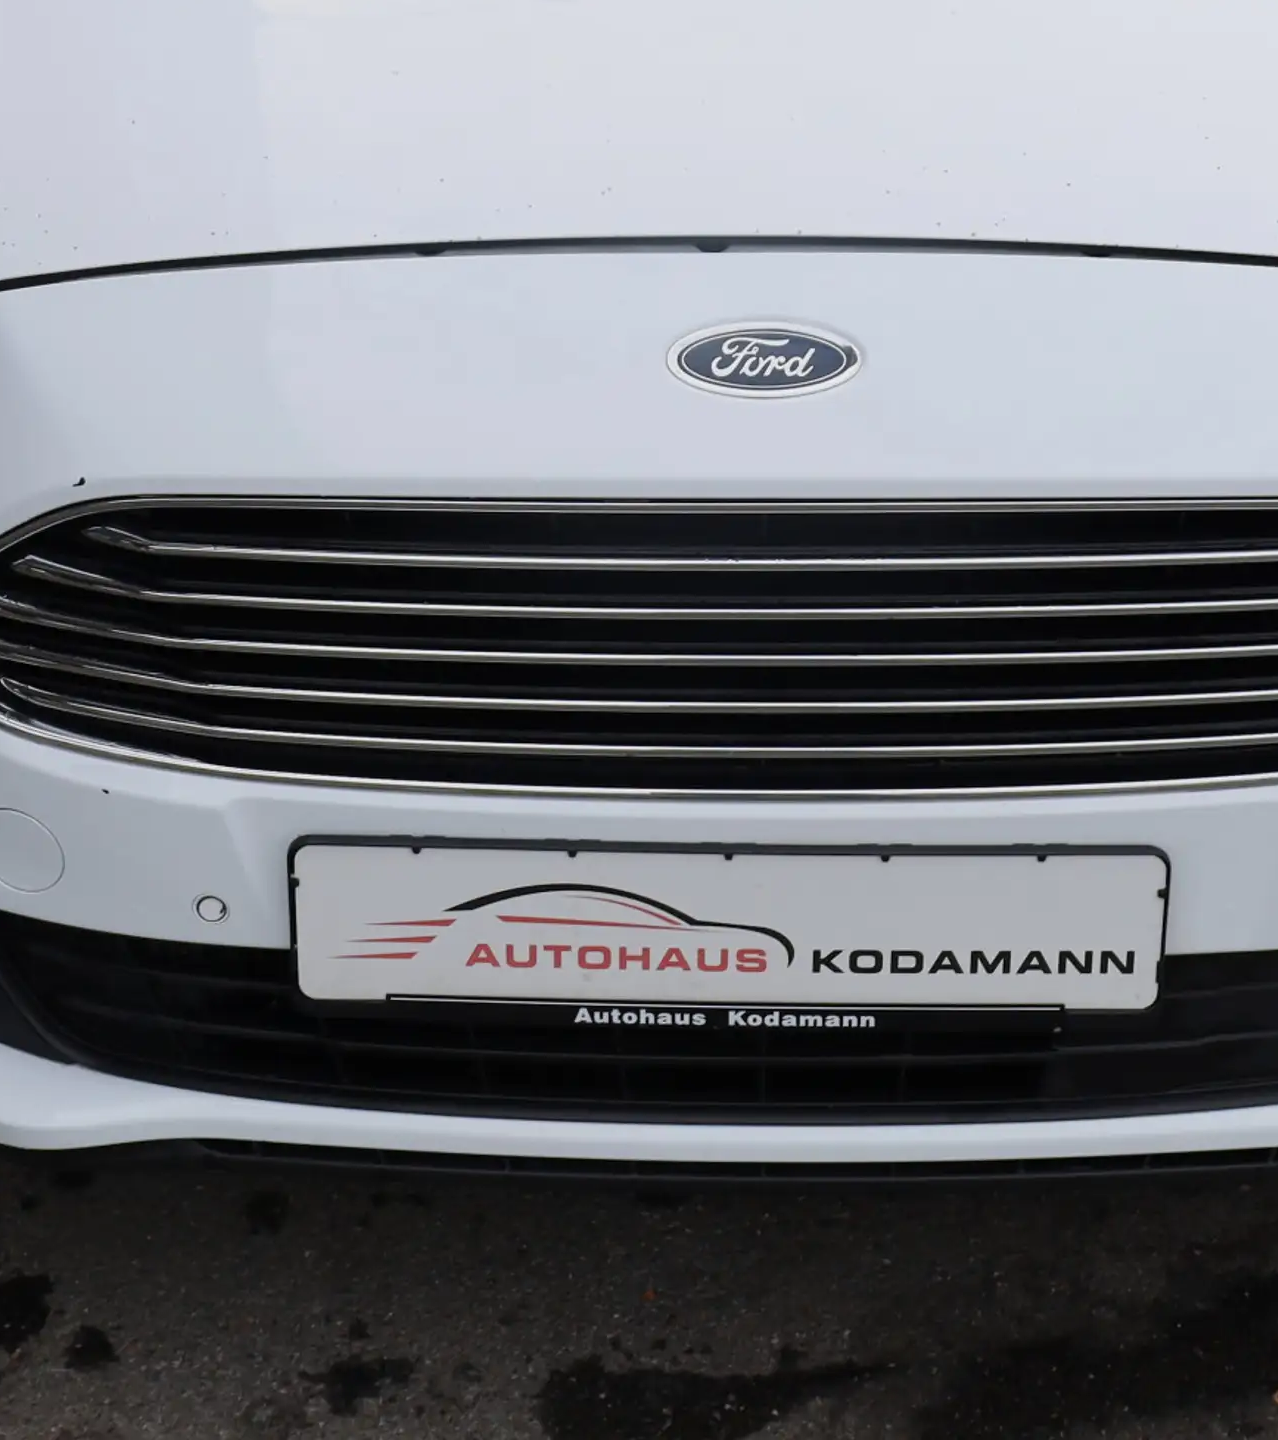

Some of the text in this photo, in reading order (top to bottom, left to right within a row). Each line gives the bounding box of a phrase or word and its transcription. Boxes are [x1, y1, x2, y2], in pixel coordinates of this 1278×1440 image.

[710, 336, 816, 378] Ford
[465, 943, 1136, 975] AUTOHAUS KODAMANN
[574, 1007, 876, 1028] Autohaus Kodamann
